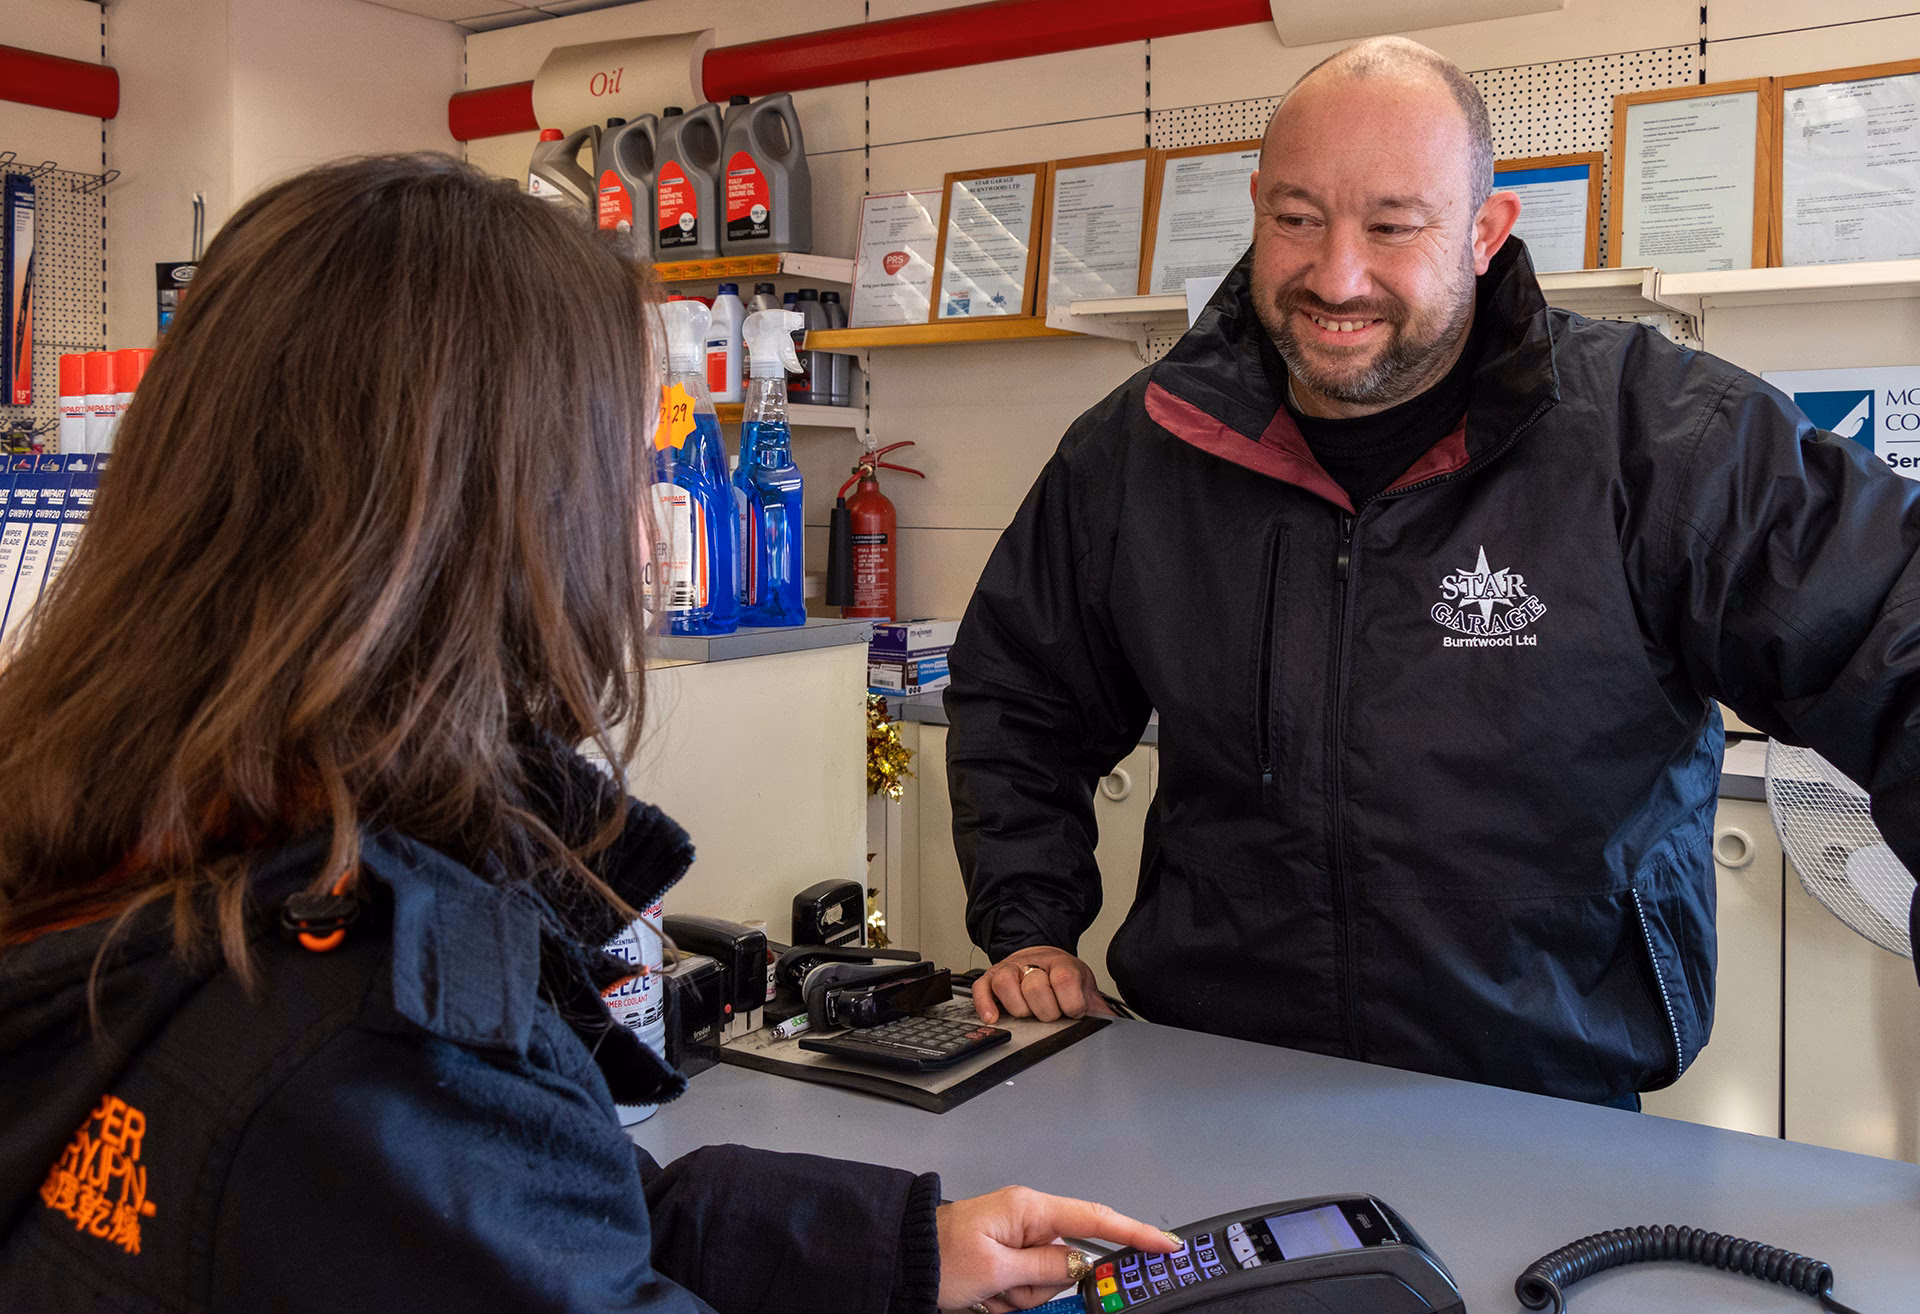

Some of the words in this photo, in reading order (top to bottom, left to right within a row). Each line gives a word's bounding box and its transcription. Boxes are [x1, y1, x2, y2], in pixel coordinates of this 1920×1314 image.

[590, 68, 623, 96] Oil
[886, 255, 904, 265] PRS
[32, 530, 49, 538] WIPER
[2, 538, 20, 546] BLADE
[1442, 574, 1528, 600] STAR
[1431, 595, 1547, 636] GARAGE
[1443, 635, 1512, 648] Burntwood
[1516, 634, 1537, 646] Ltd
